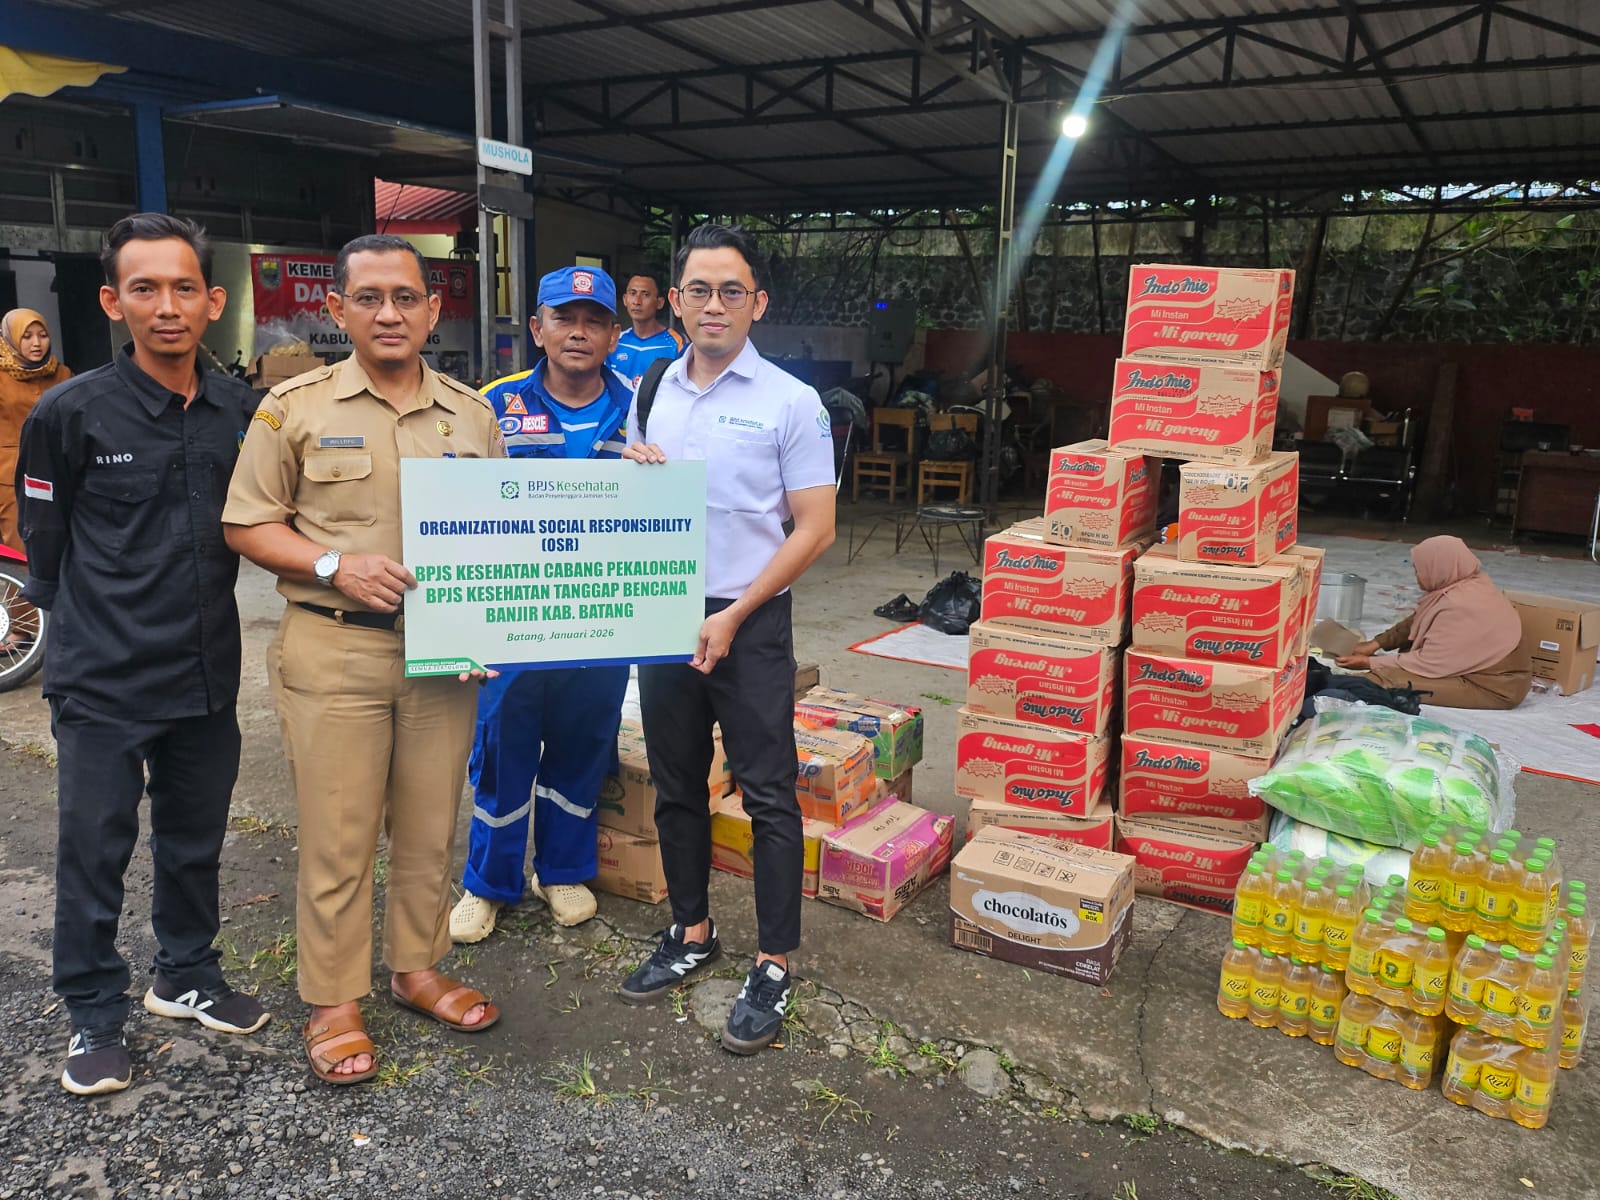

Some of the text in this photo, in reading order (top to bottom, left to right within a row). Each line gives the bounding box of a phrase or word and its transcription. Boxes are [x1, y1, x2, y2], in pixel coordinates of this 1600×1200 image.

[482, 143, 529, 164] MUSHOLA
[288, 262, 334, 278] KEME
[1151, 309, 1189, 320] Mi Instan
[309, 333, 352, 346] KABU
[1135, 402, 1173, 414] Mi Instan
[523, 415, 546, 430] RESCUE
[96, 453, 133, 464] RINO
[528, 480, 619, 491] BPJS Kesehatan
[419, 518, 692, 535] ORGANIZATIONAL SOCIAL RESPONSIBILITY
[541, 538, 579, 552] (OSR)
[415, 560, 697, 582] BPJS KESEHATAN CABANG PEKALONGAN
[426, 580, 688, 604] BPJS KESEHATAN TANGGAP BENCANA
[1004, 581, 1040, 594] Mi Instan
[486, 602, 634, 623] BANJIR KAB. BATANG
[1212, 614, 1254, 627] Mi Instan
[506, 629, 614, 643] Batang, Januari 2026
[1150, 692, 1189, 706] Mi Instan
[1145, 779, 1184, 793] Mi Instan
[1008, 931, 1042, 945] DELIGHT
[1485, 1074, 1513, 1089] Rizki
